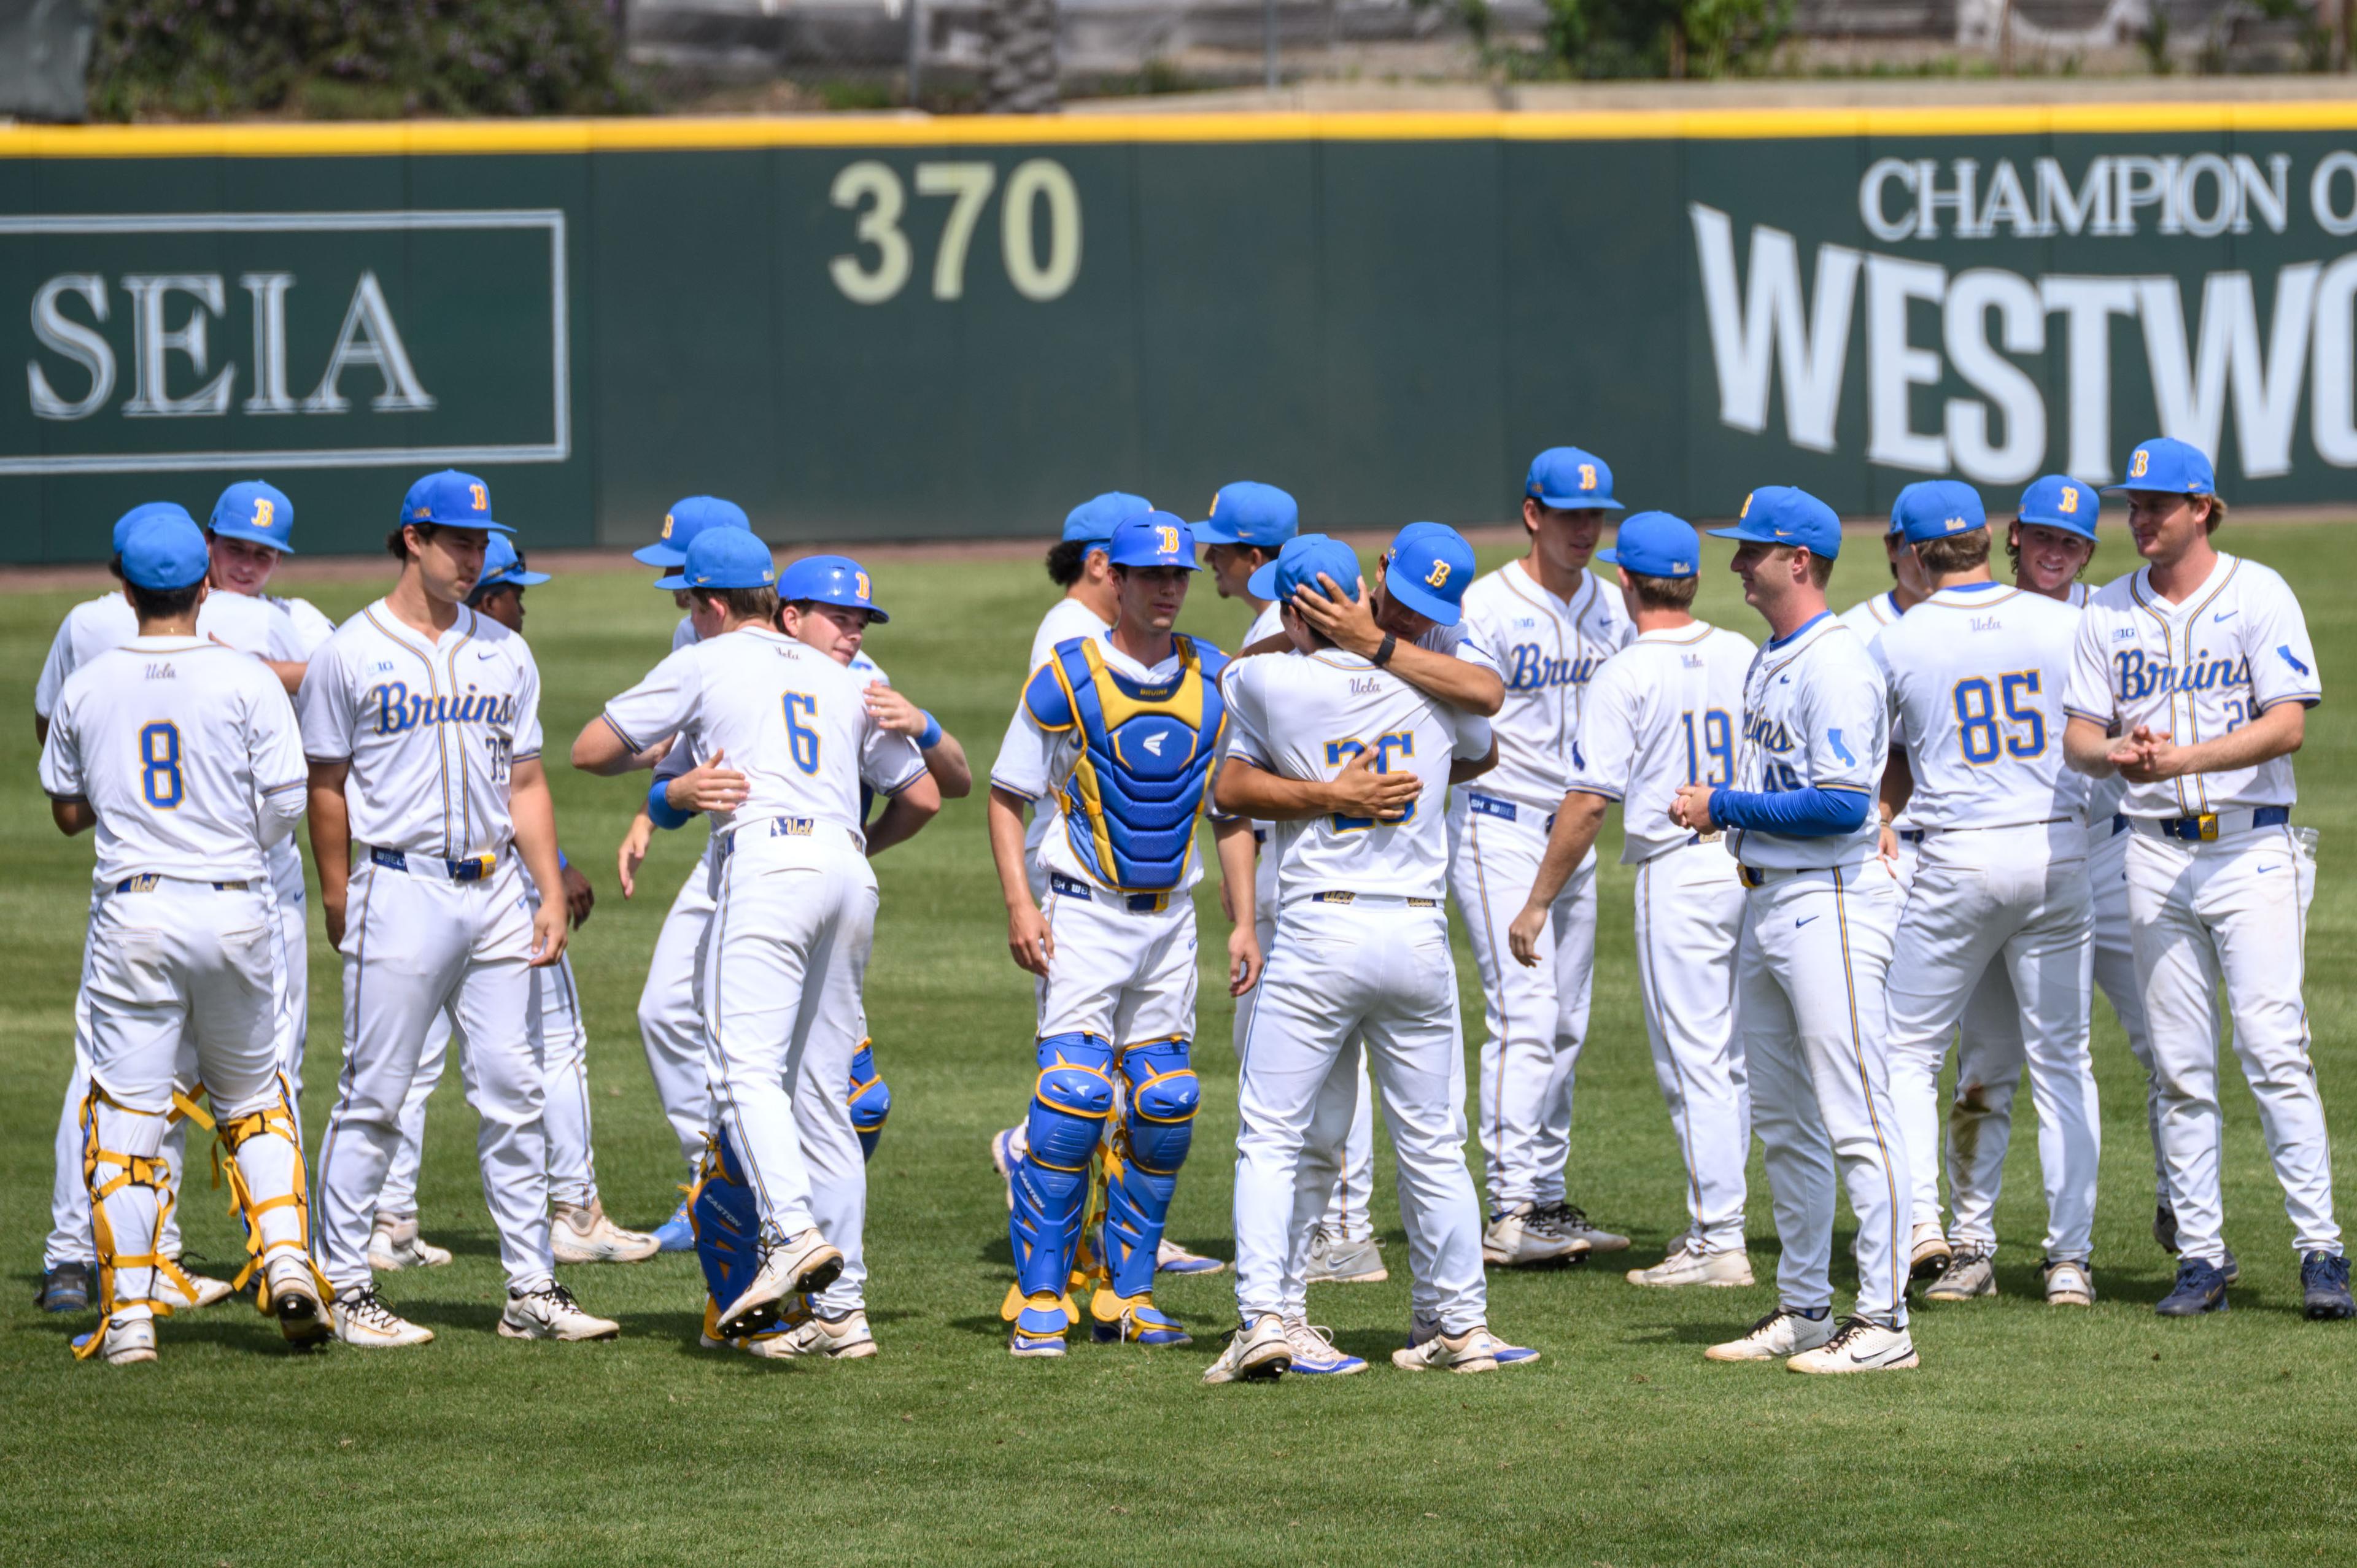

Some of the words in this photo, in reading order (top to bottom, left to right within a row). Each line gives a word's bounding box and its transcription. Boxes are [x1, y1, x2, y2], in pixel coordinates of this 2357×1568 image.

[1859, 153, 2291, 242] CHAMPION
[829, 159, 1083, 303] 370
[26, 270, 437, 420] SEIA
[1578, 463, 1597, 490] B
[2130, 449, 2149, 477] B
[251, 498, 274, 528] B
[469, 484, 487, 511] B
[2058, 486, 2078, 514] B
[1159, 526, 1179, 553] B
[855, 571, 870, 600] B
[1425, 559, 1451, 588] B
[1350, 677, 1382, 694] Ucla
[2113, 647, 2252, 704] Bruins
[371, 681, 514, 737] Bruins
[1951, 668, 2049, 768] 85
[780, 689, 821, 778] 6
[1682, 706, 1737, 792] 19
[137, 719, 186, 811] 8
[1019, 1170, 1045, 1209] EASTON
[704, 1194, 742, 1227] EASTON
